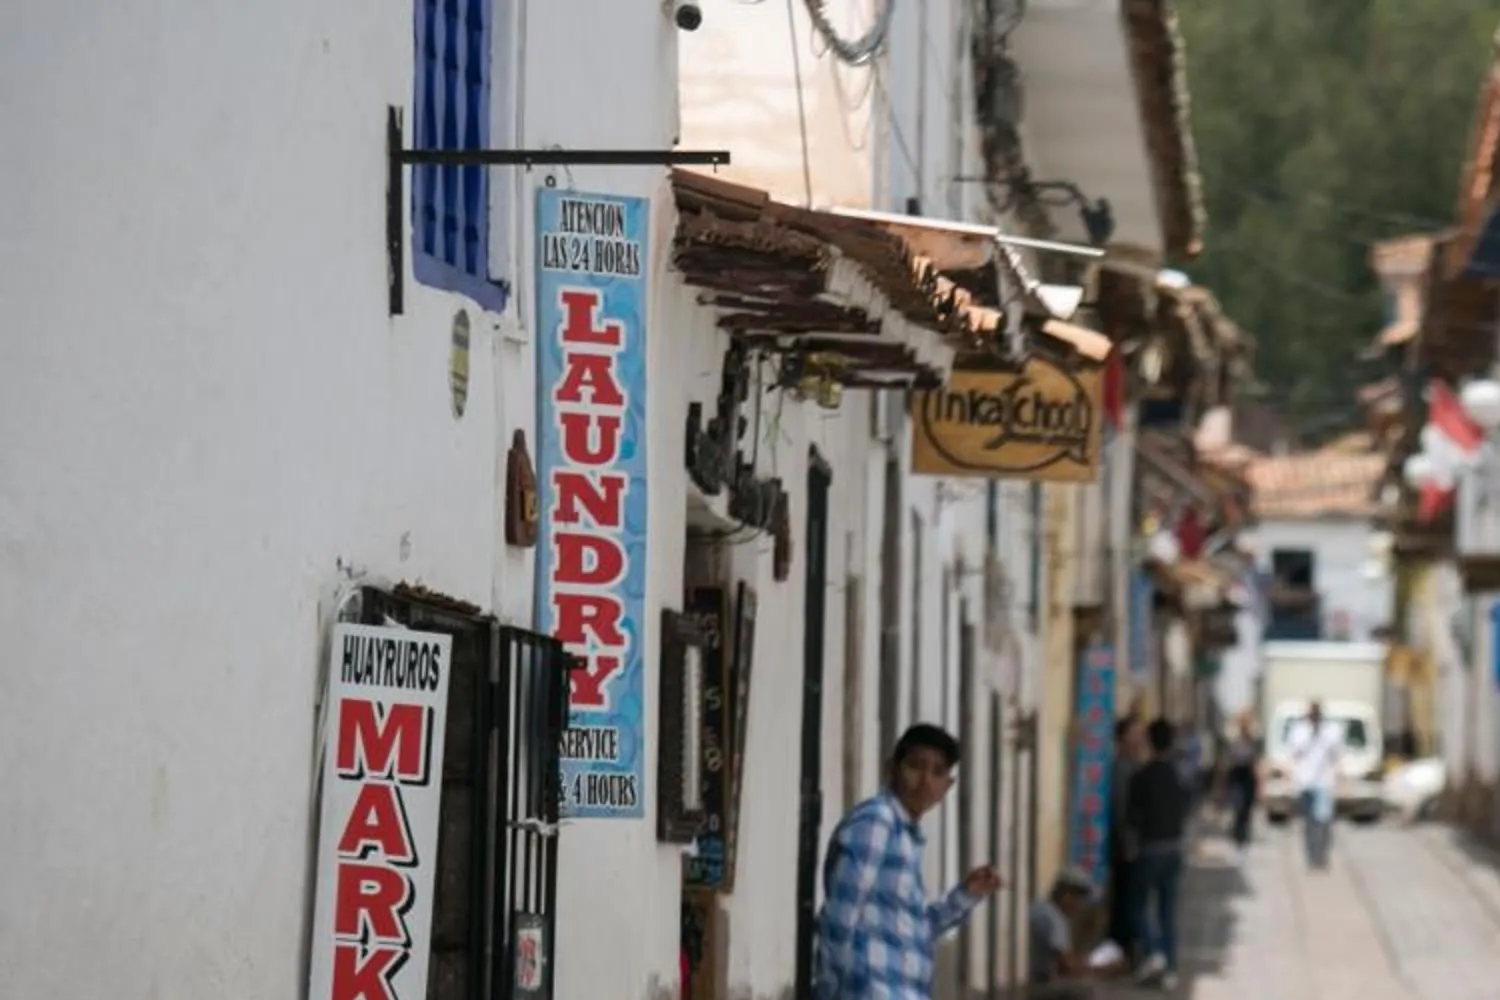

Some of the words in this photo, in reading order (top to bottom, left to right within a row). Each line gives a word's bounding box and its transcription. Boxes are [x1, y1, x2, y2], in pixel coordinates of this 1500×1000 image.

[560, 199, 625, 237] ATENCION
[543, 235, 567, 269] LAS
[570, 237, 590, 271] 24
[593, 239, 640, 275] HORAS
[552, 290, 626, 707] LAUNDRY
[341, 634, 440, 692] HUAYRUROS
[559, 726, 617, 760] SERVICE
[587, 773, 637, 806] HOURS
